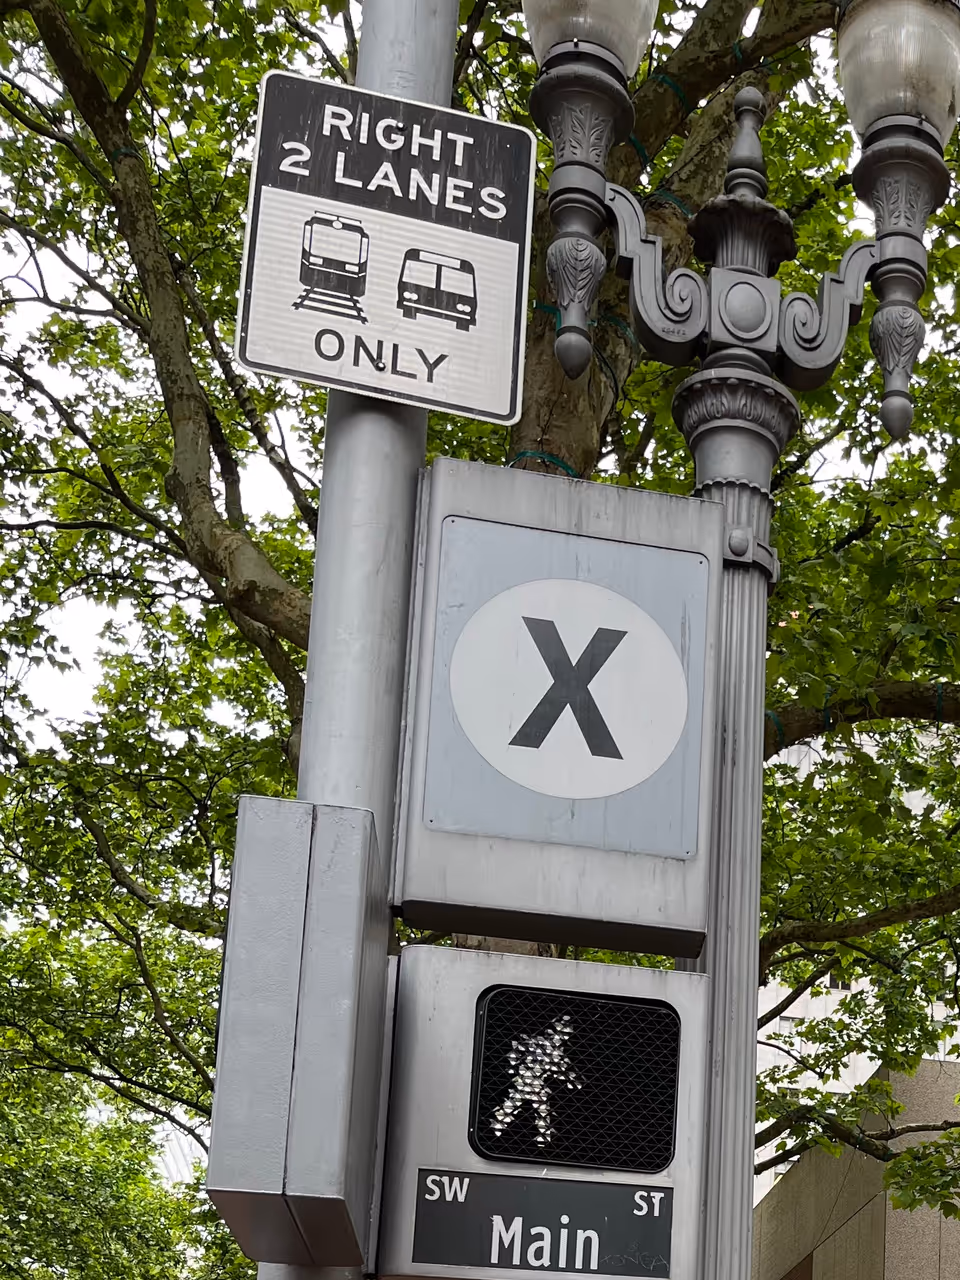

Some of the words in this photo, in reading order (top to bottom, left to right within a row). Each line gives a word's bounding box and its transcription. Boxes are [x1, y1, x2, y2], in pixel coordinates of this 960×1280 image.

[322, 104, 474, 167] RIGHT
[279, 142, 311, 176] 2
[335, 152, 507, 220] LANES
[314, 328, 449, 383] ONLY
[508, 616, 628, 760] X
[424, 1175, 470, 1202] SW
[633, 1191, 665, 1217] ST
[490, 1214, 600, 1270] Main
